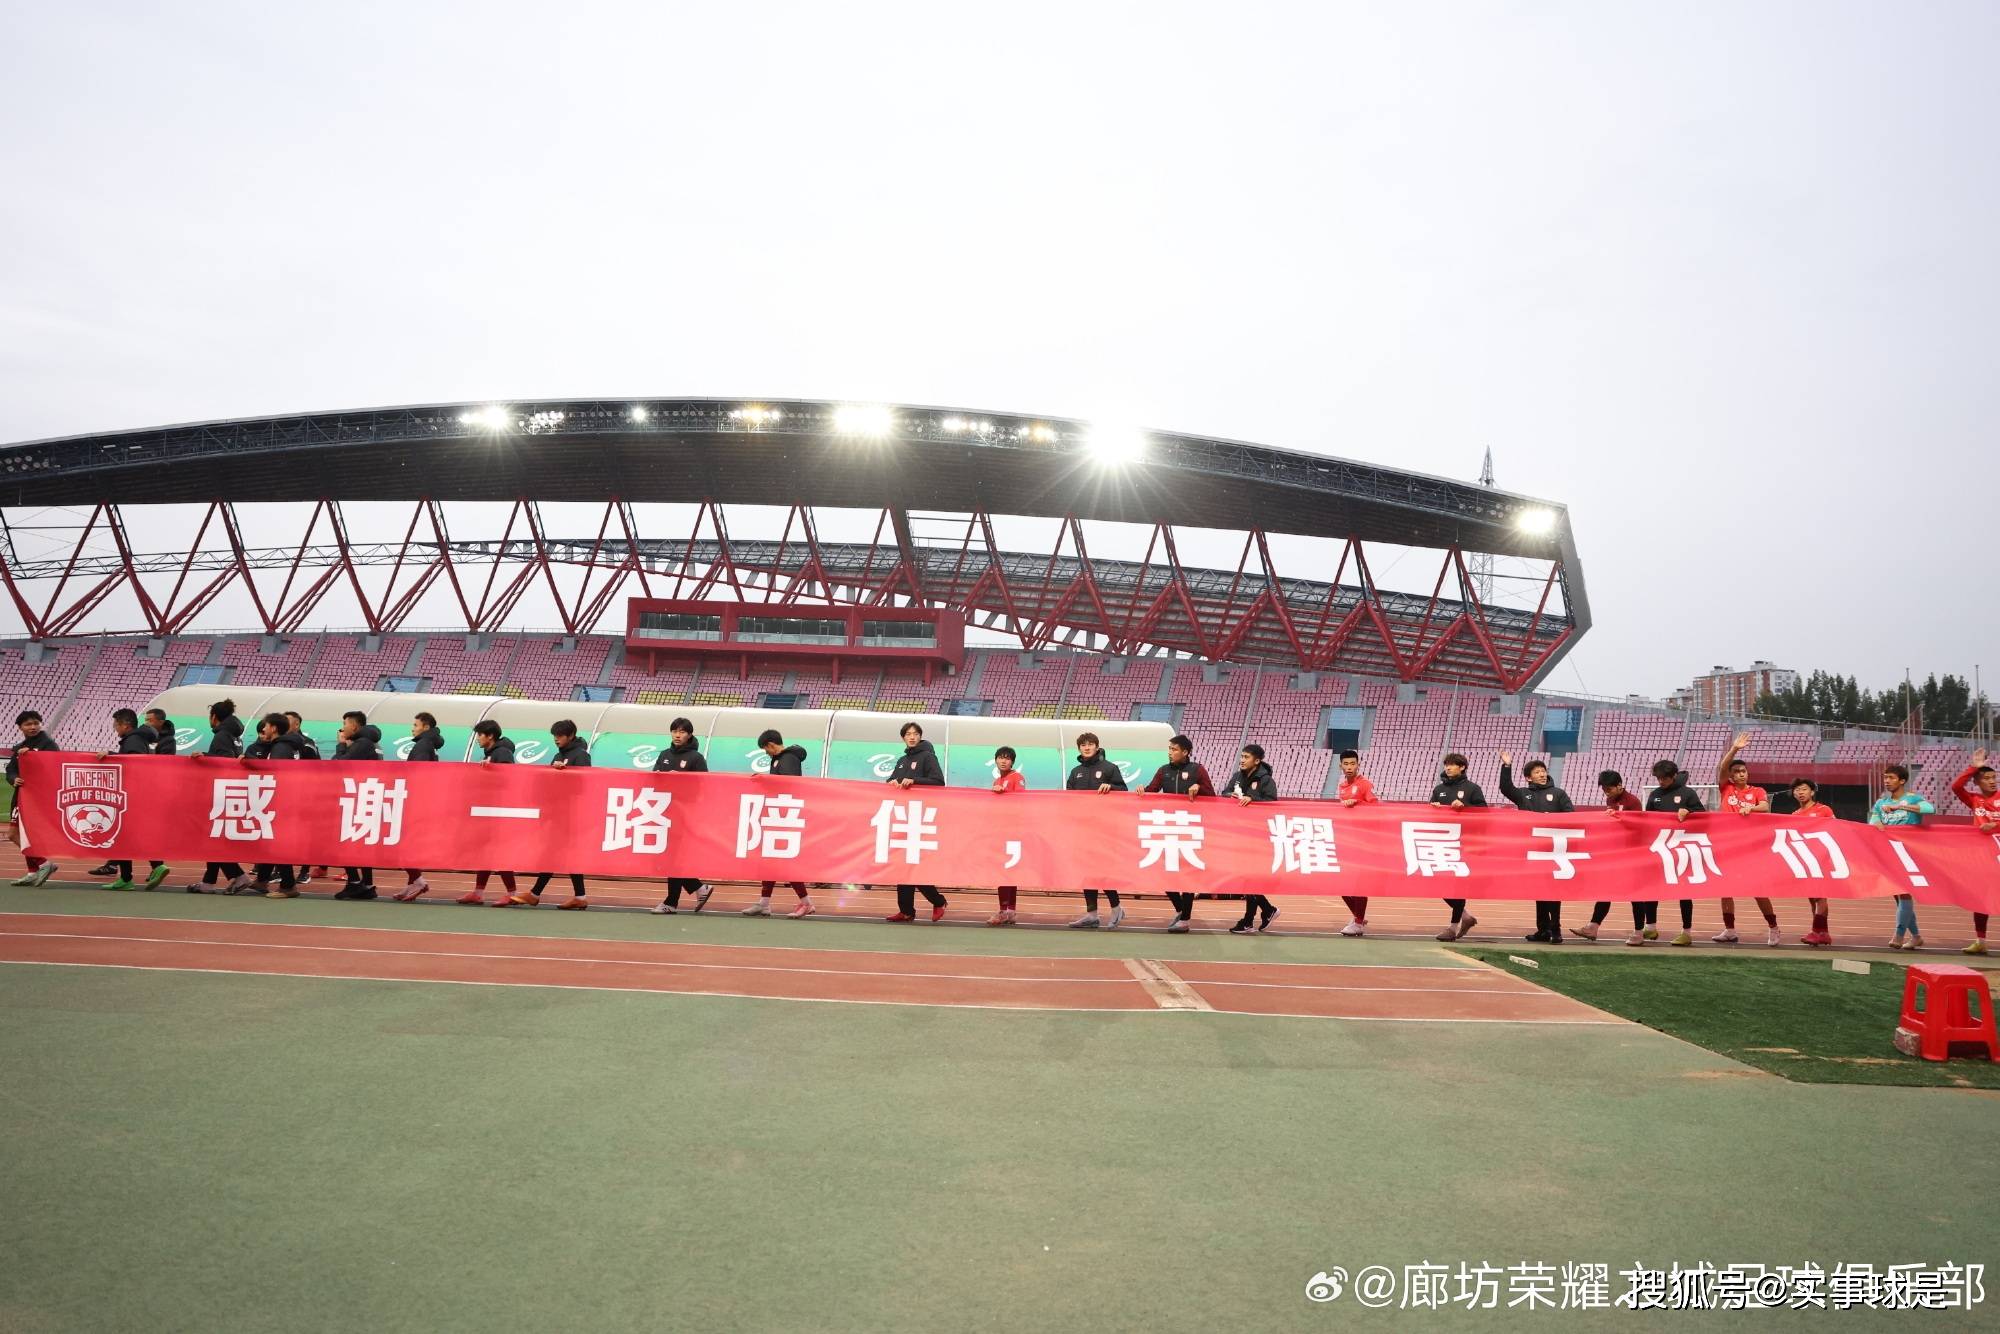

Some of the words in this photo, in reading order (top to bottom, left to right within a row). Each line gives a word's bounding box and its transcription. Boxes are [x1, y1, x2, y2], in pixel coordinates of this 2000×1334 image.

[69, 771, 114, 789] LANGFANG
[61, 790, 80, 804] CITY
[81, 789, 93, 800] OF
[94, 789, 123, 805] GLORY
[209, 775, 1929, 887] 感谢一路陪伴，荣耀属于你们！
